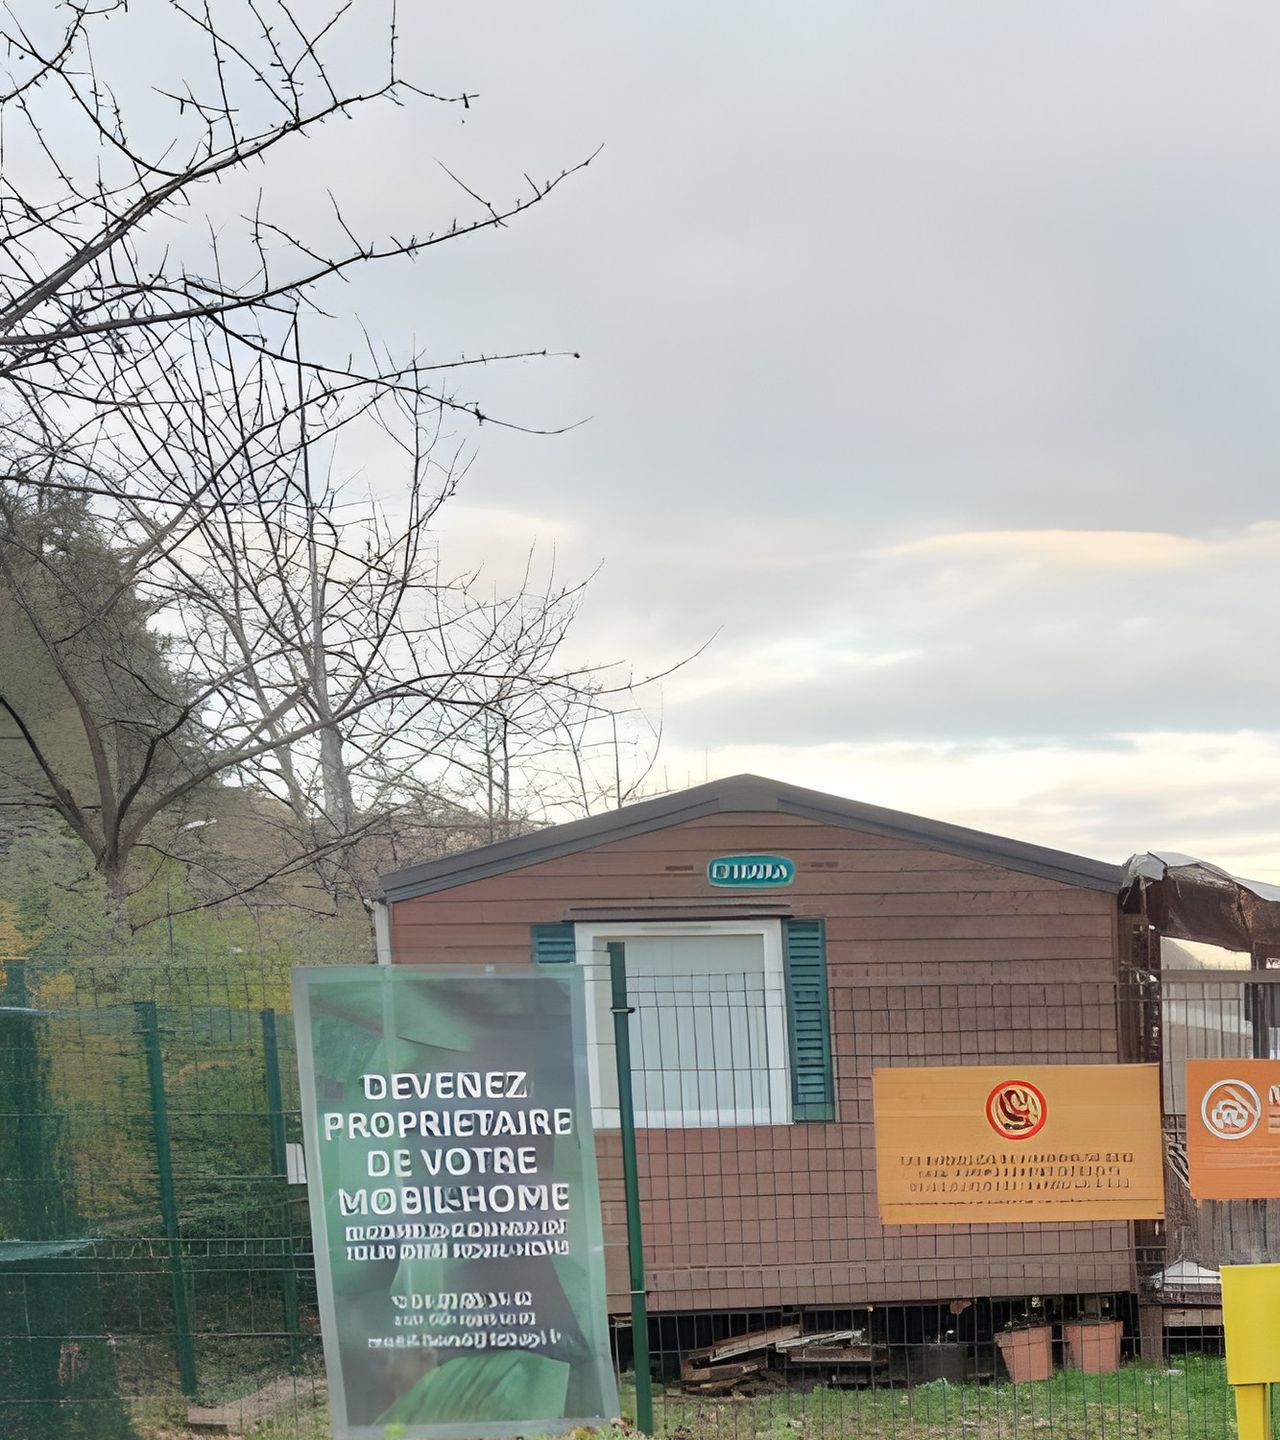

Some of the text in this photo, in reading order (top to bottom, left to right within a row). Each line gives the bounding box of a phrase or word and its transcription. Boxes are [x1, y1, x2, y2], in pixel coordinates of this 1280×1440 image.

[363, 1071, 528, 1100] DEVENEZ
[367, 1146, 538, 1177] DE VOTRE
